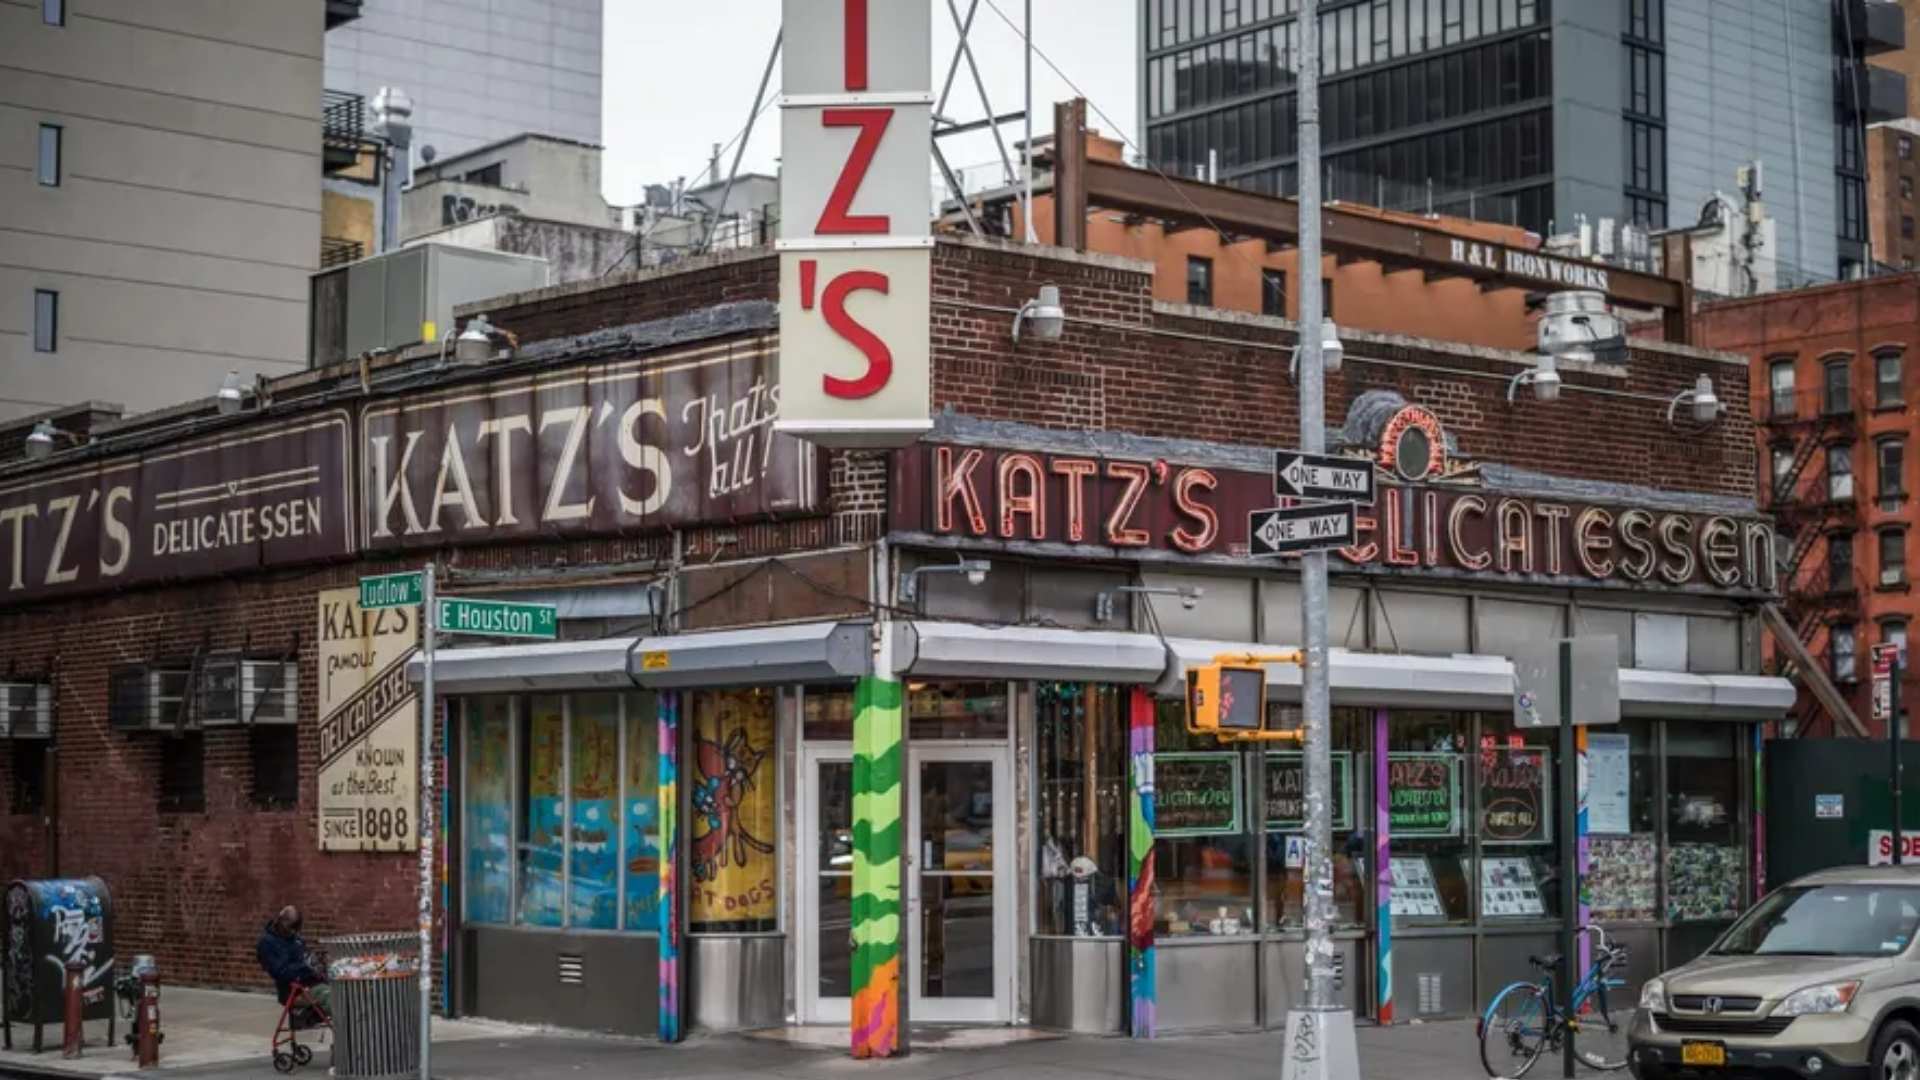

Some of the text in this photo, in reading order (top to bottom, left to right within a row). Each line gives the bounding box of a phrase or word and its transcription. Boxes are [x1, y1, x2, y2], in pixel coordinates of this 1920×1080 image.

[371, 398, 673, 538] KATZ'S
[1289, 466, 1362, 489] ONE WAY
[936, 446, 1219, 553] KATZ'S
[153, 497, 323, 556] DELICATESSEN
[1265, 517, 1342, 541] ONE WAY
[361, 580, 409, 608] Ludlow
[442, 603, 553, 632] E Houston St
[323, 818, 356, 839] SINCE
[1288, 840, 1299, 859] A
[1880, 835, 1920, 856] SDE
